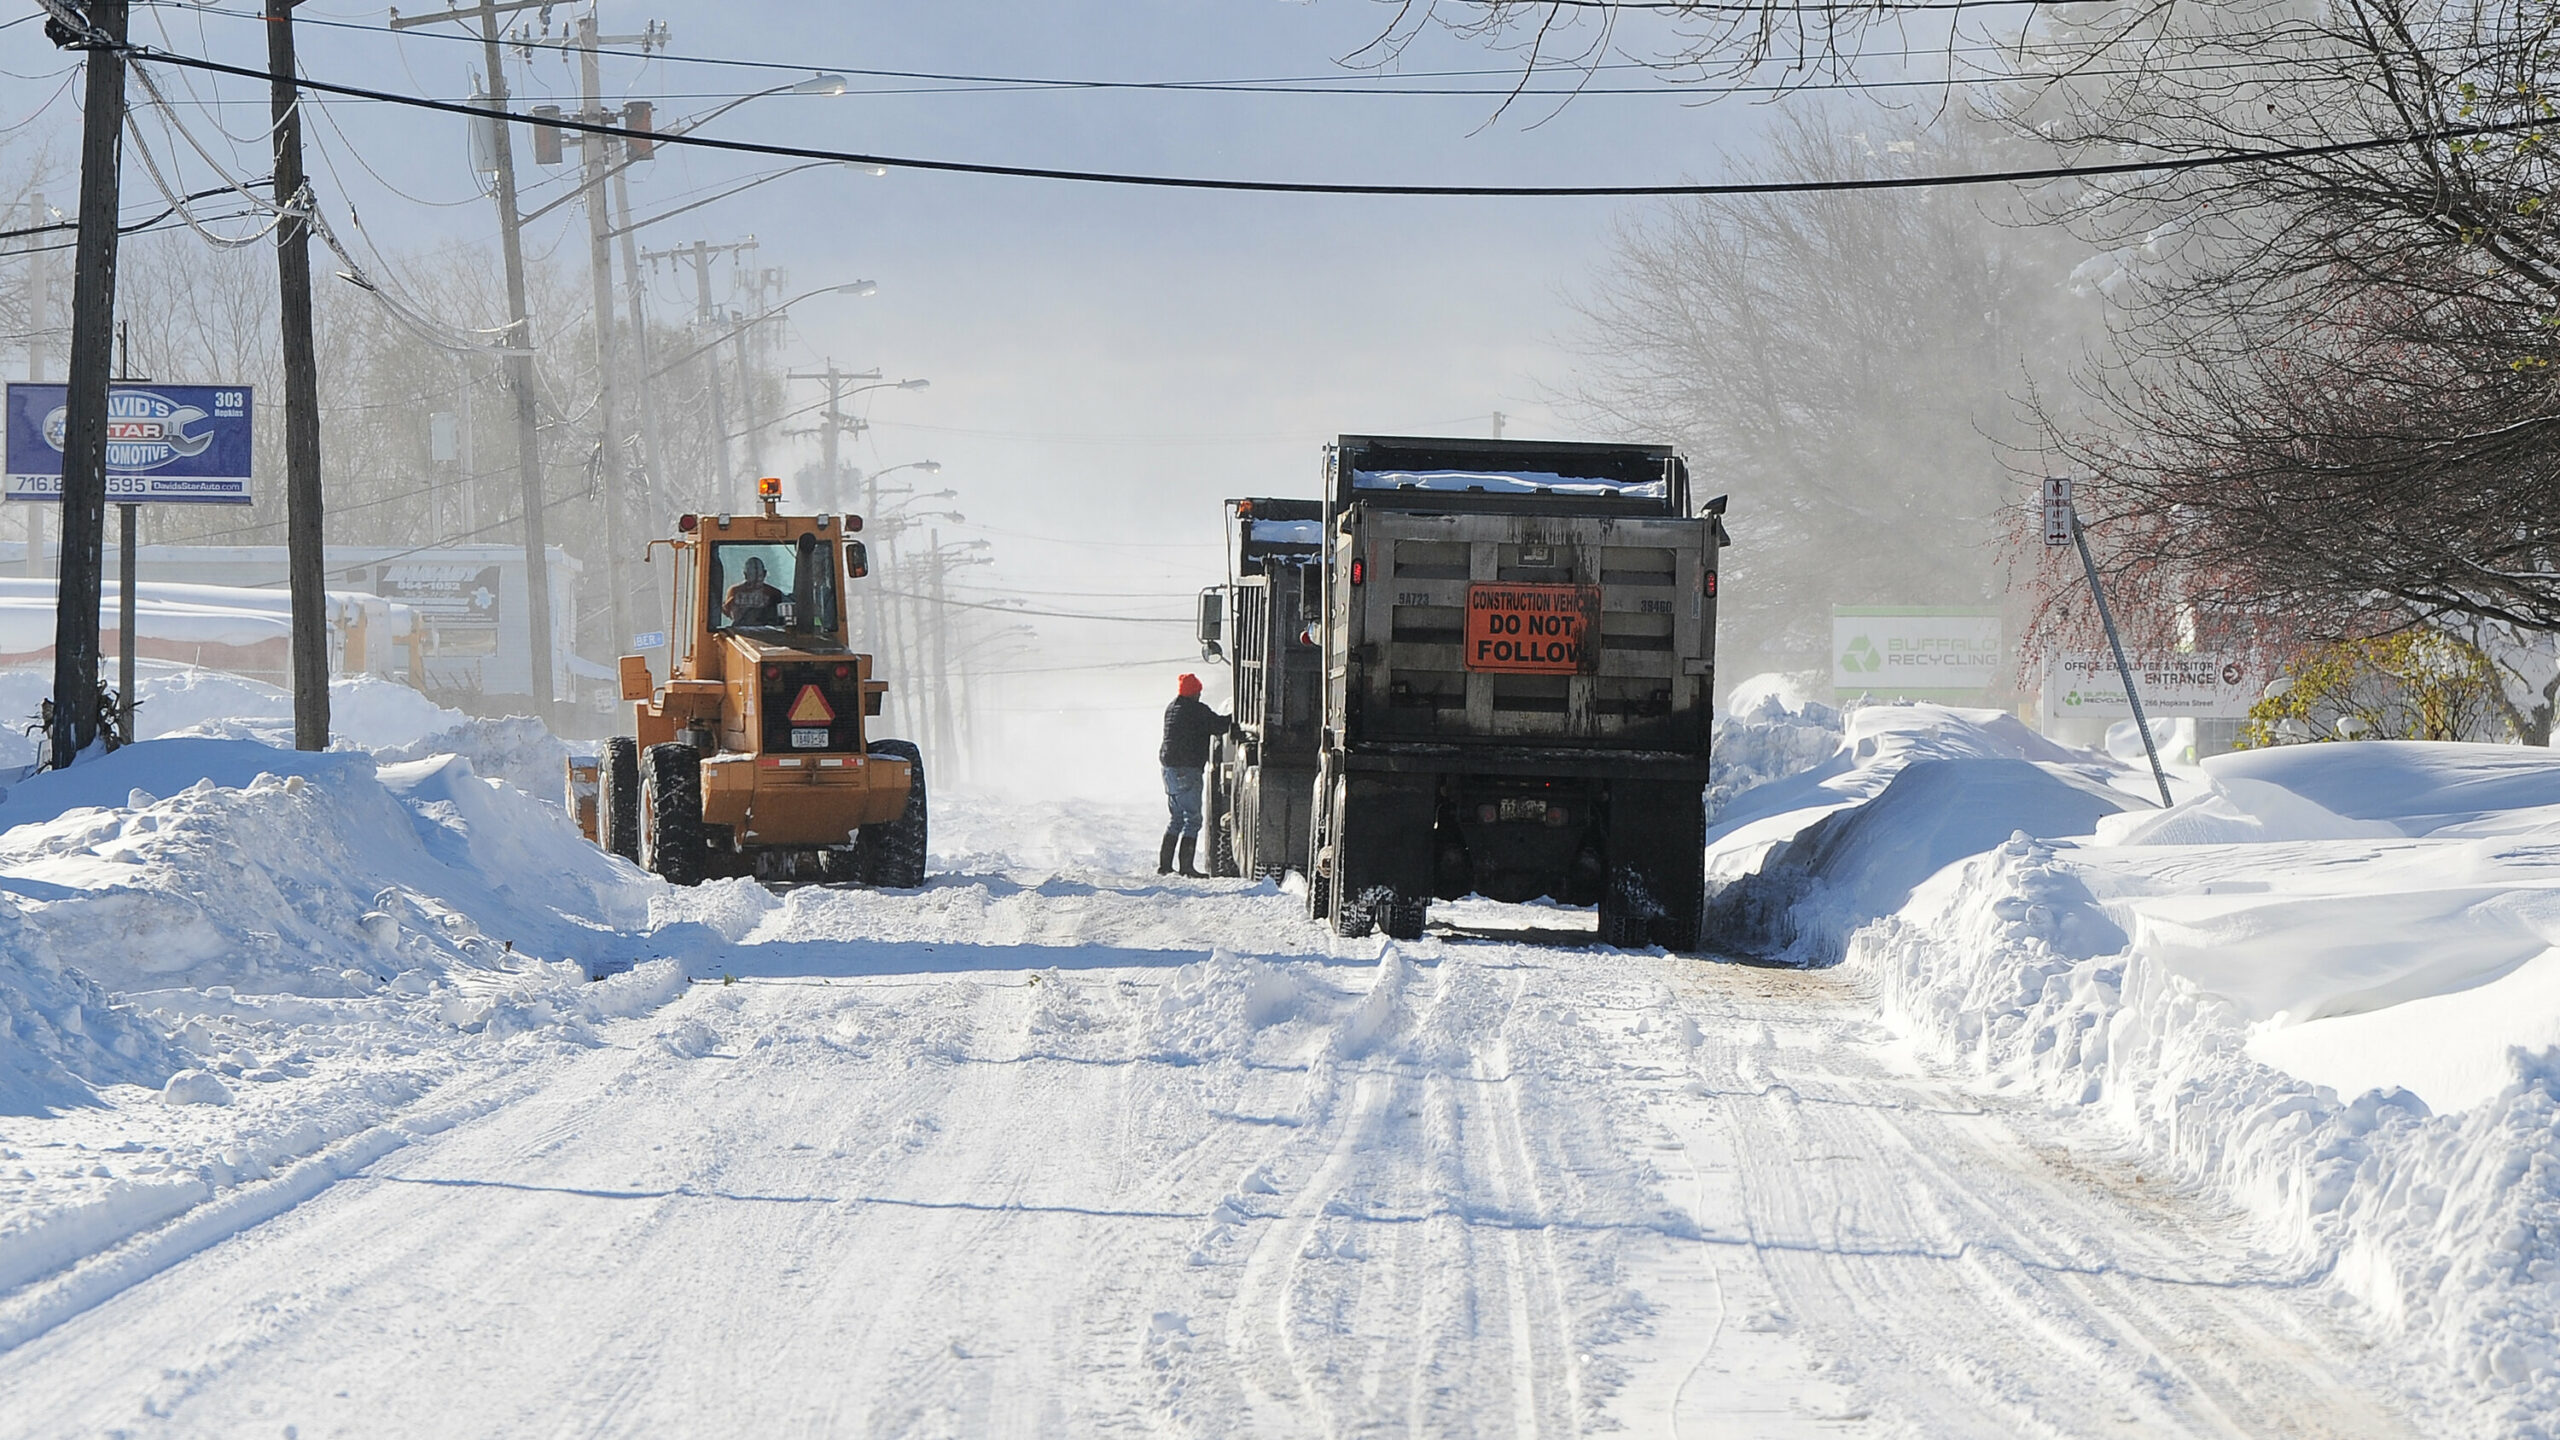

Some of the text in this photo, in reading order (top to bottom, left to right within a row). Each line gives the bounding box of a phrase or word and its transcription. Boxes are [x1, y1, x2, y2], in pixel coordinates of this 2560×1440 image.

[215, 392, 243, 408] 303
[108, 397, 169, 417] AVID'S
[214, 409, 244, 418] Hopkins
[110, 424, 160, 437] TAR
[106, 445, 169, 464] TOMOTIVE
[154, 481, 240, 491] DavidsStarAuto.com
[1473, 591, 1550, 612] CONSTRUCTION
[1490, 614, 1574, 636] DO NOT
[1888, 638, 1997, 651] BUFFALO
[1888, 654, 1998, 665] RECYCLING
[2173, 662, 2214, 671] VISITOR
[2145, 673, 2214, 684] ENTRANCE
[2160, 700, 2189, 708] Hopkins
